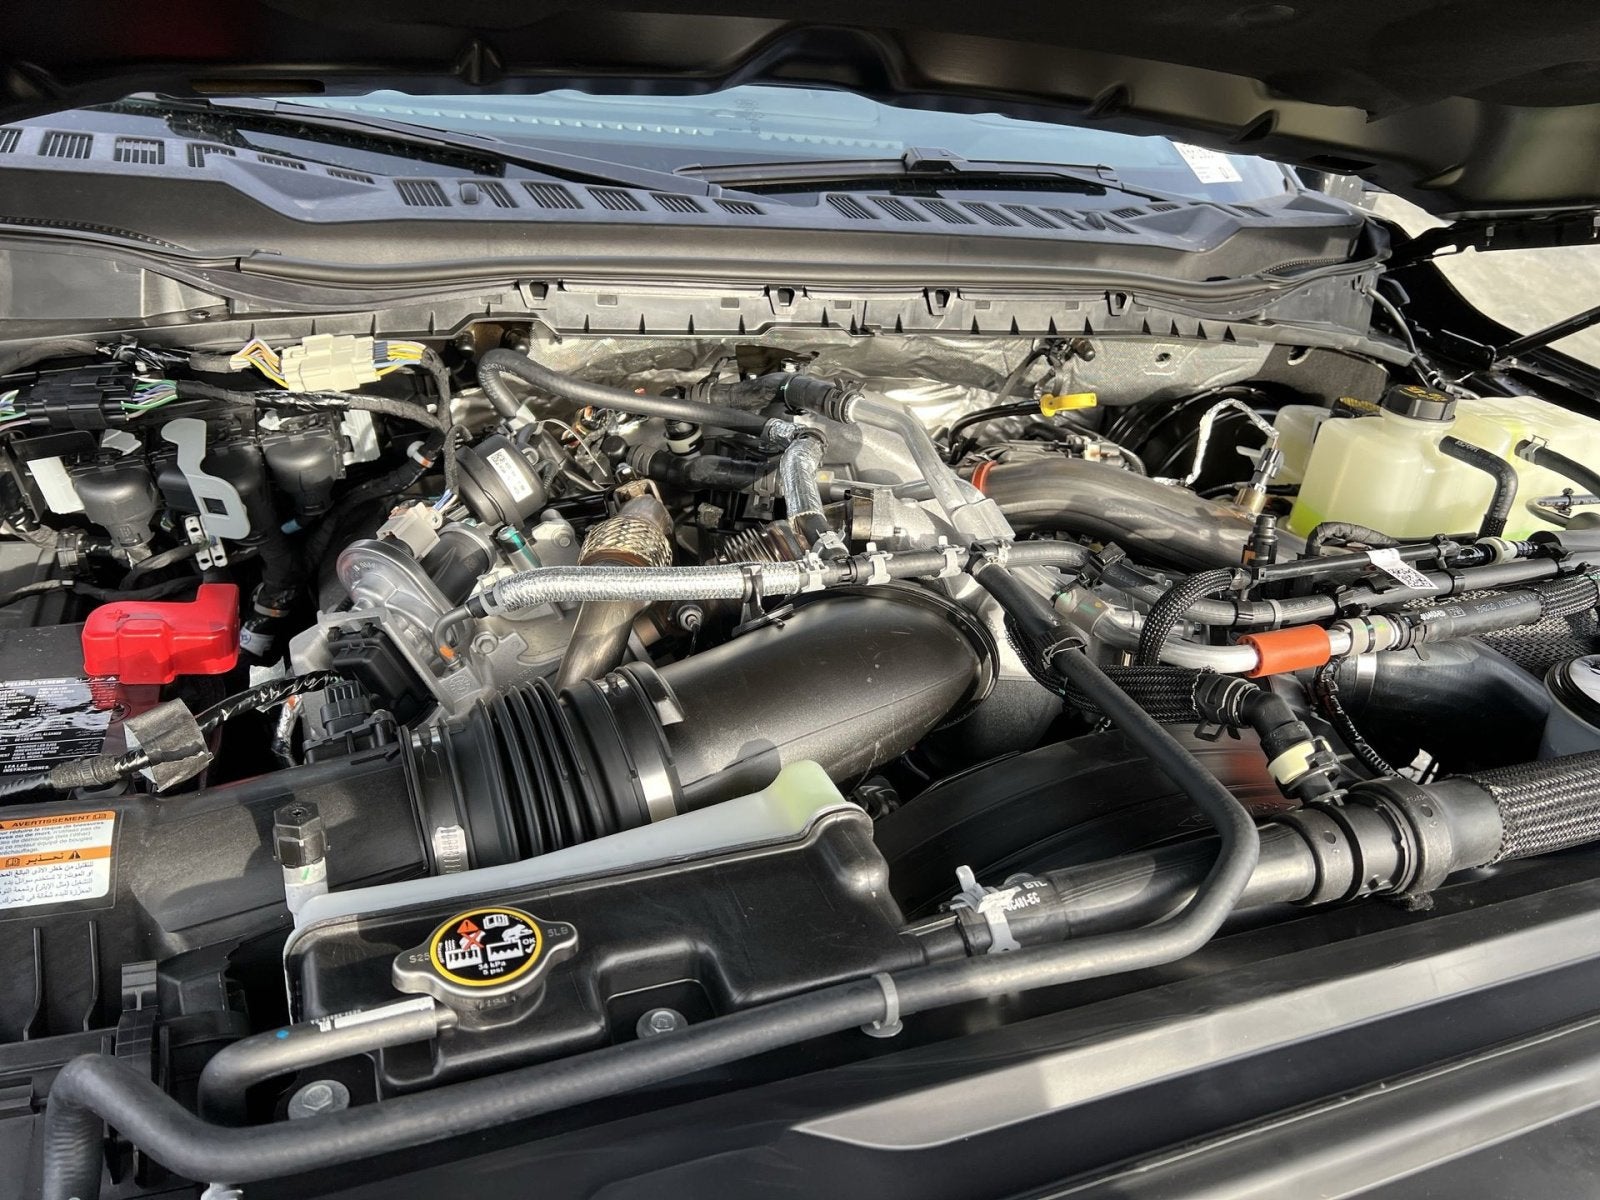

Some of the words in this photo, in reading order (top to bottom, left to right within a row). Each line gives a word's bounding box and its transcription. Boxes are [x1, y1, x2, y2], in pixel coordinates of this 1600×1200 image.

[12, 815, 89, 827] AVERTISSEMENT
[522, 937, 536, 946] OK
[478, 963, 489, 971] 34
[490, 960, 507, 968] kPa
[490, 967, 504, 976] psi
